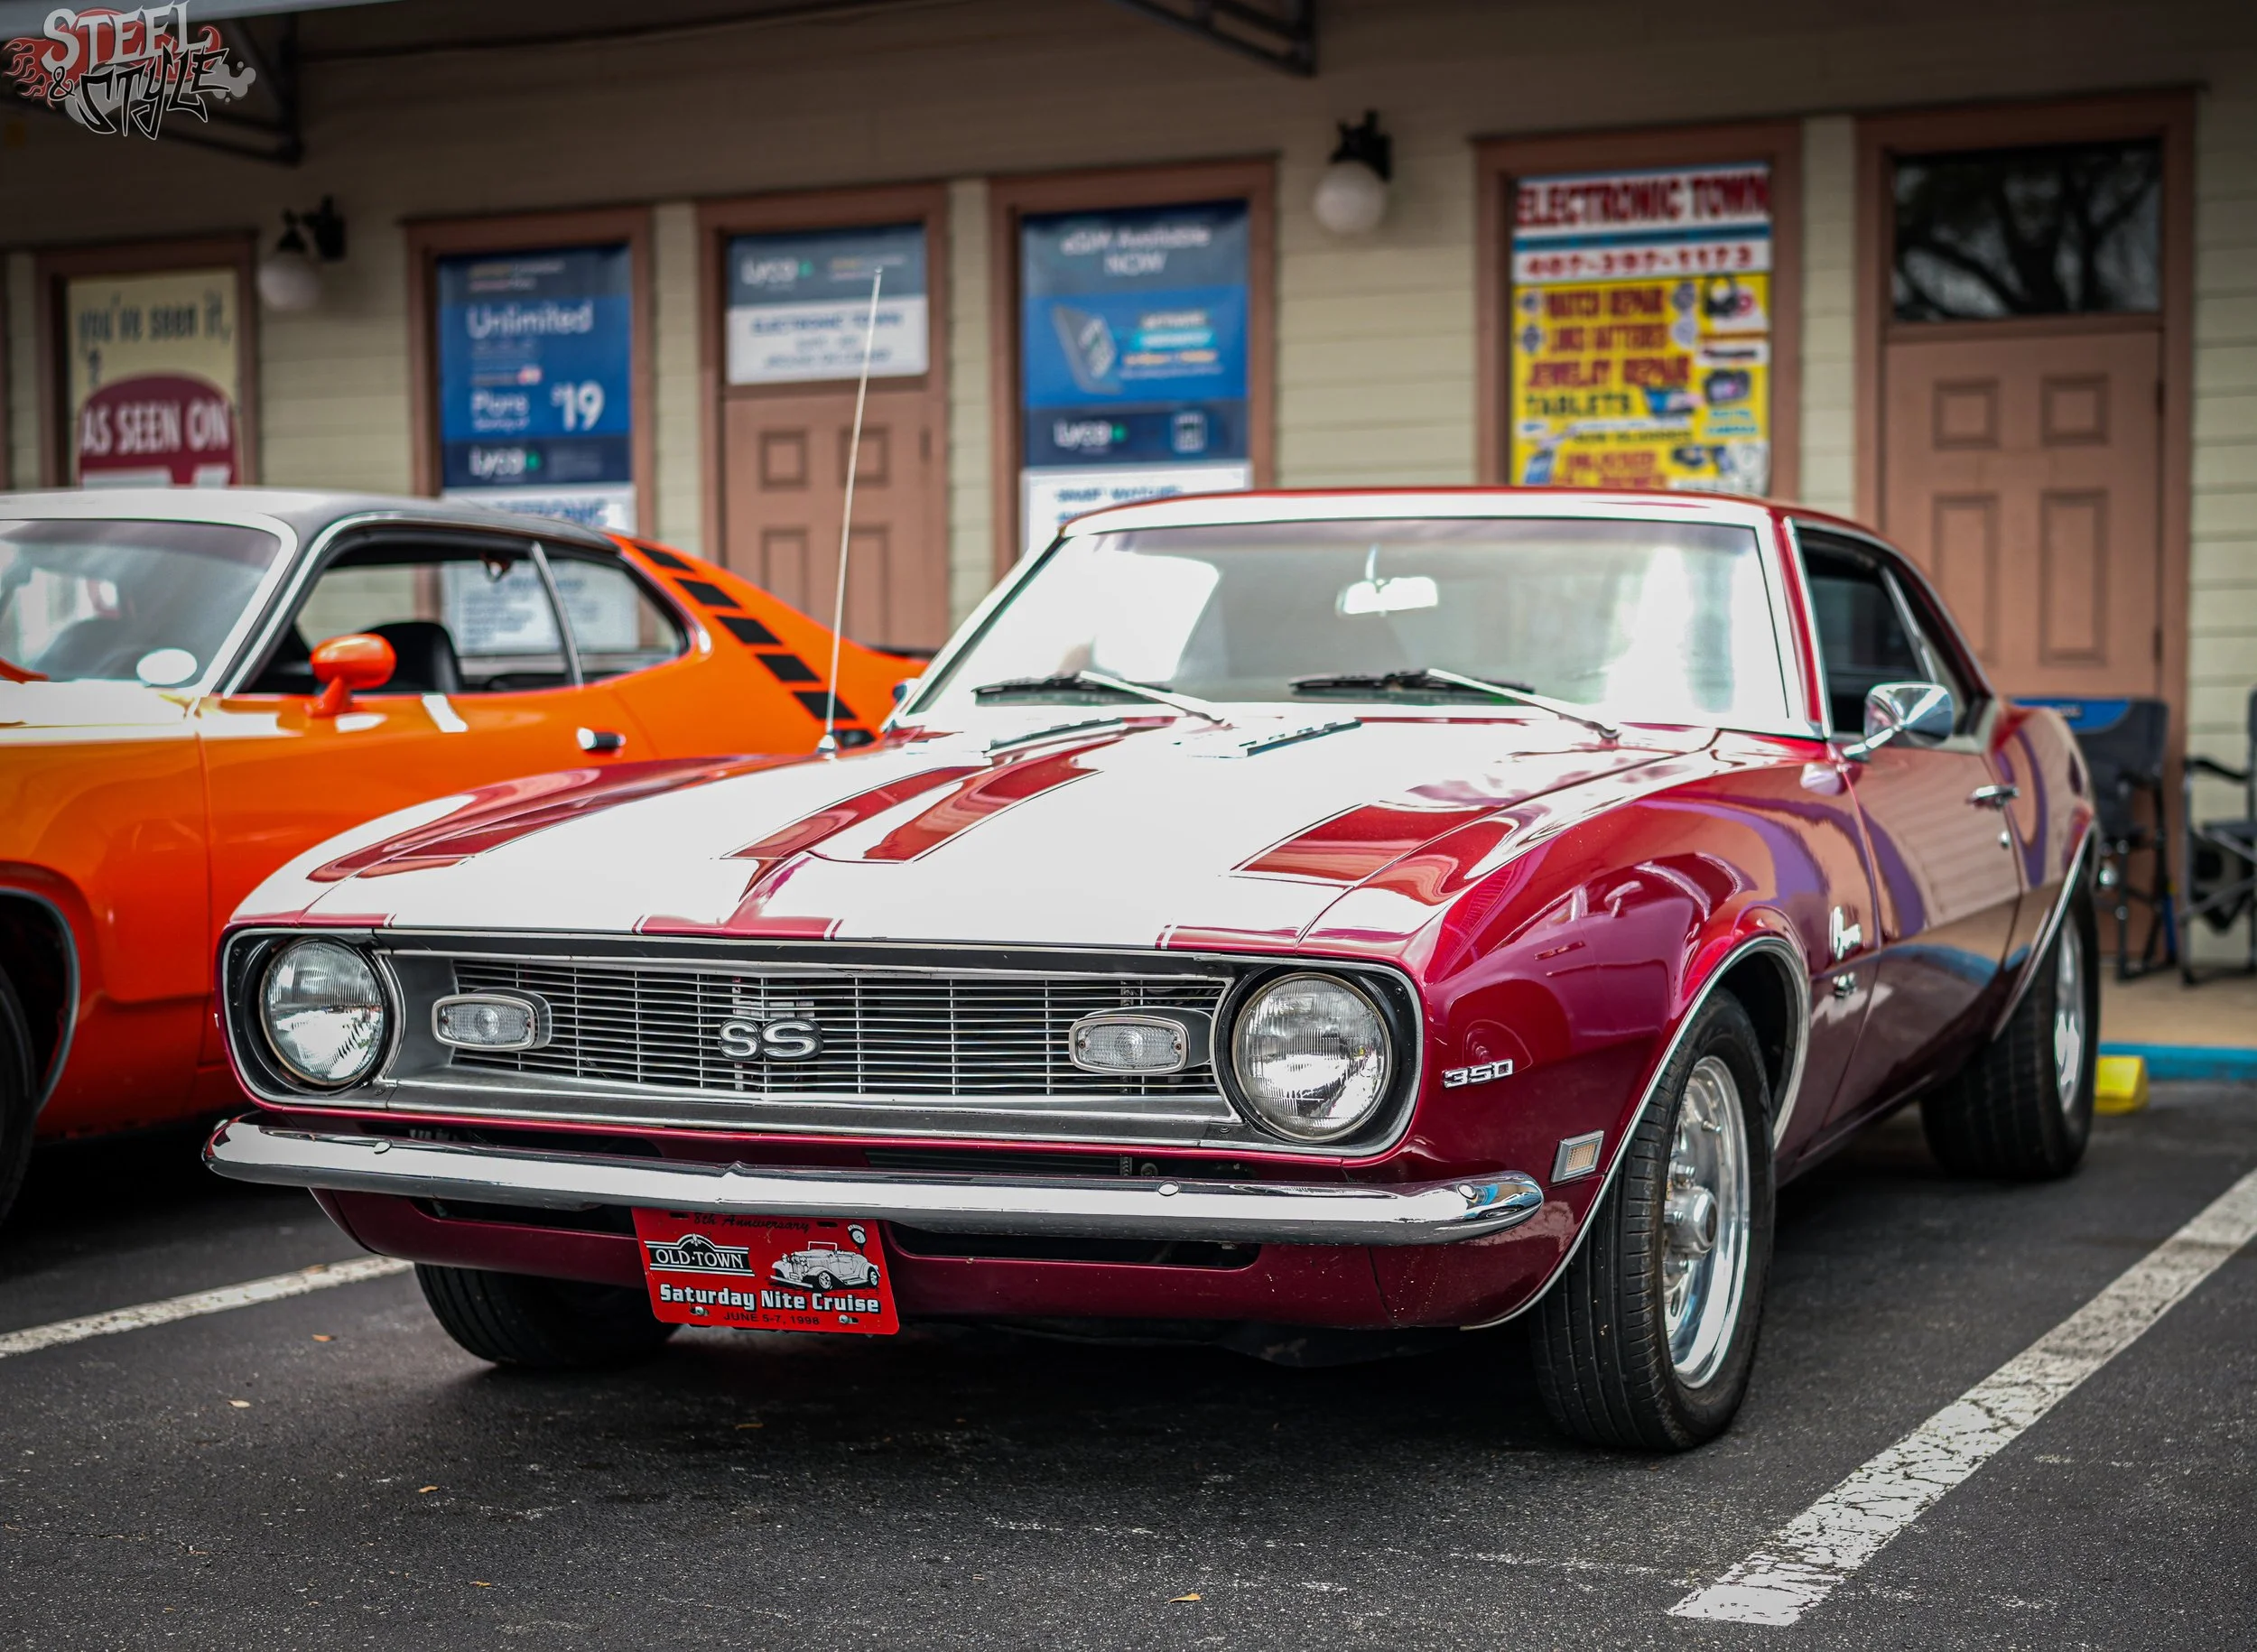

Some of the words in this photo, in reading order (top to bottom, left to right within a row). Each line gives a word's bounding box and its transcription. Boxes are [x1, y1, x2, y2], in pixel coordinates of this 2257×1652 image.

[1516, 176, 1682, 227] ELECTRONIC
[1690, 172, 1769, 218] TOWN
[468, 300, 592, 338] Unlimited
[80, 404, 112, 454] AS
[116, 401, 181, 454] SEEN
[186, 397, 230, 451] ON
[718, 1017, 823, 1061] SS
[1442, 1058, 1514, 1089] 350
[721, 1214, 810, 1233] Anniversary
[660, 1284, 756, 1310] Saturday
[760, 1290, 806, 1310] Nite
[812, 1293, 880, 1313] Cruise
[723, 1312, 759, 1323] JUNE
[792, 1315, 821, 1325] 1998
